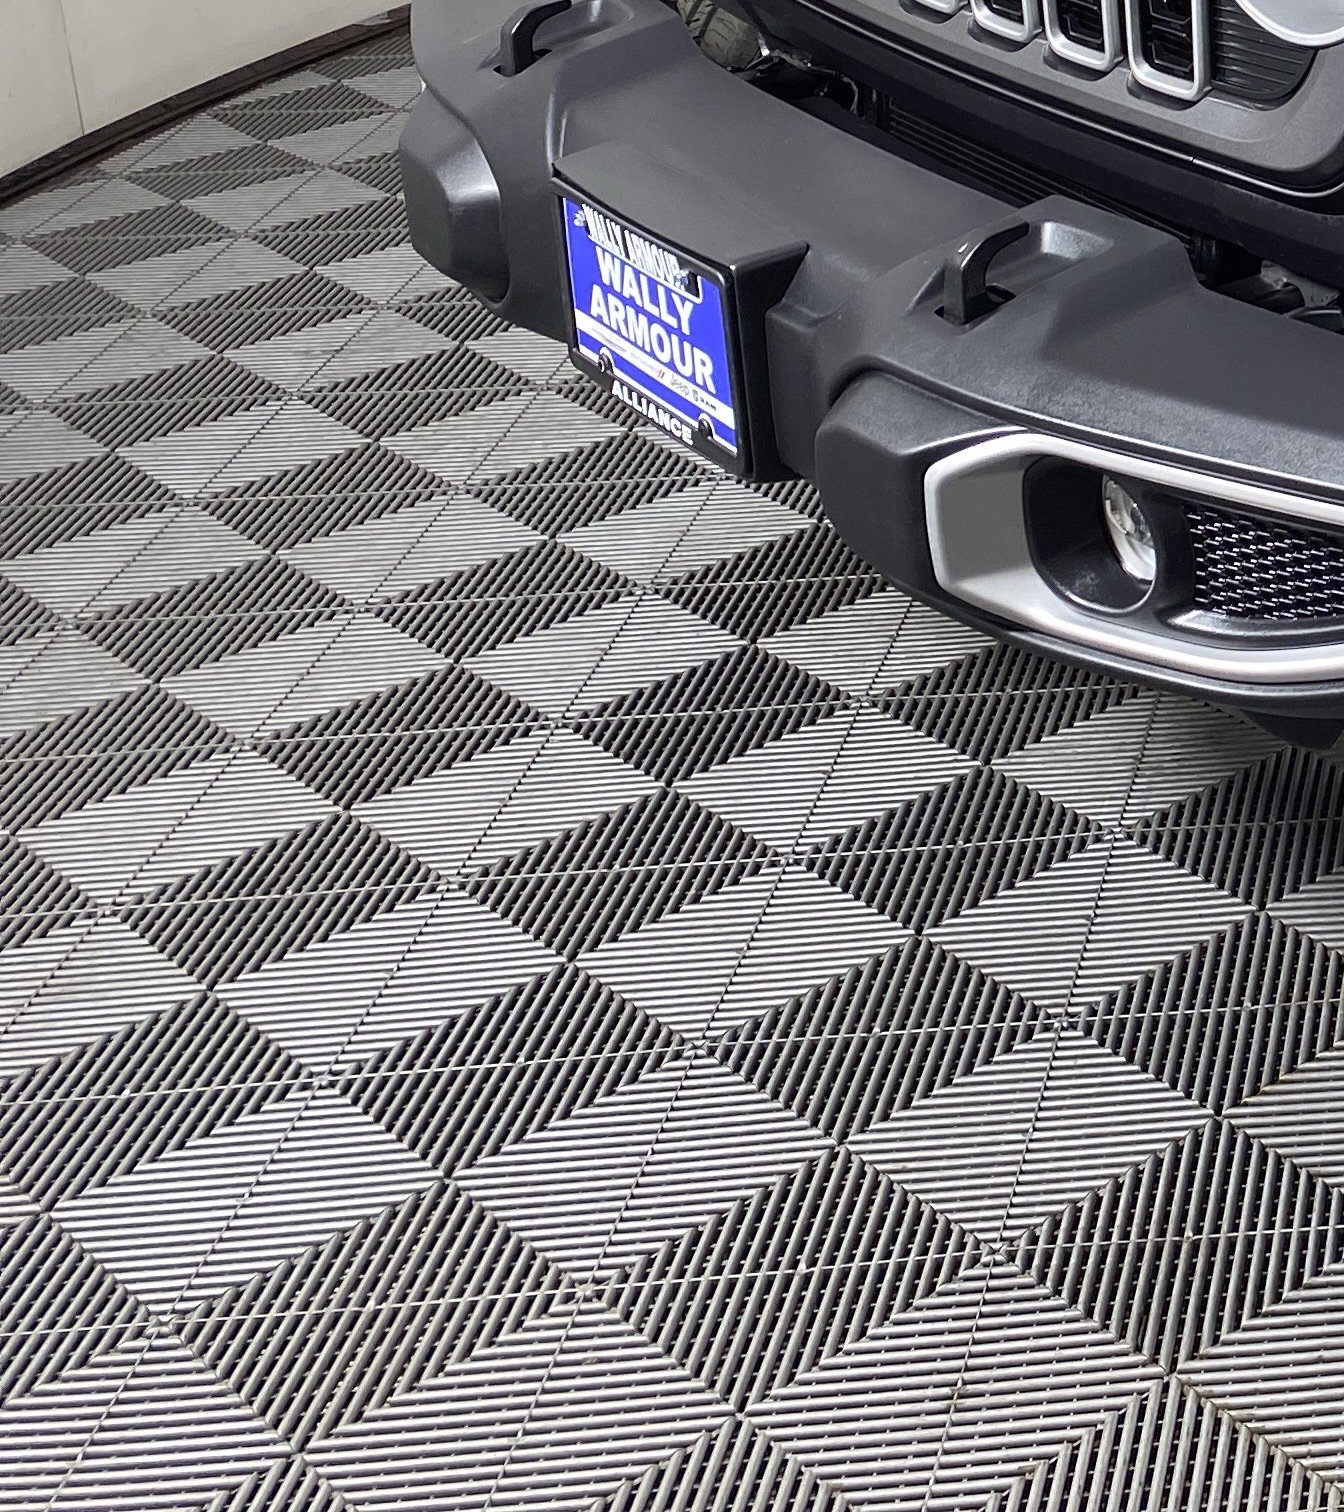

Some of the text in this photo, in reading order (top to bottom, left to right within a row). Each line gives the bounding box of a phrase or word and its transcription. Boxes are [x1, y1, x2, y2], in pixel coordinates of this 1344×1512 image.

[595, 246, 694, 335] WALLY
[590, 283, 717, 395] ARMOUR
[611, 379, 694, 445] ALLIANCE
